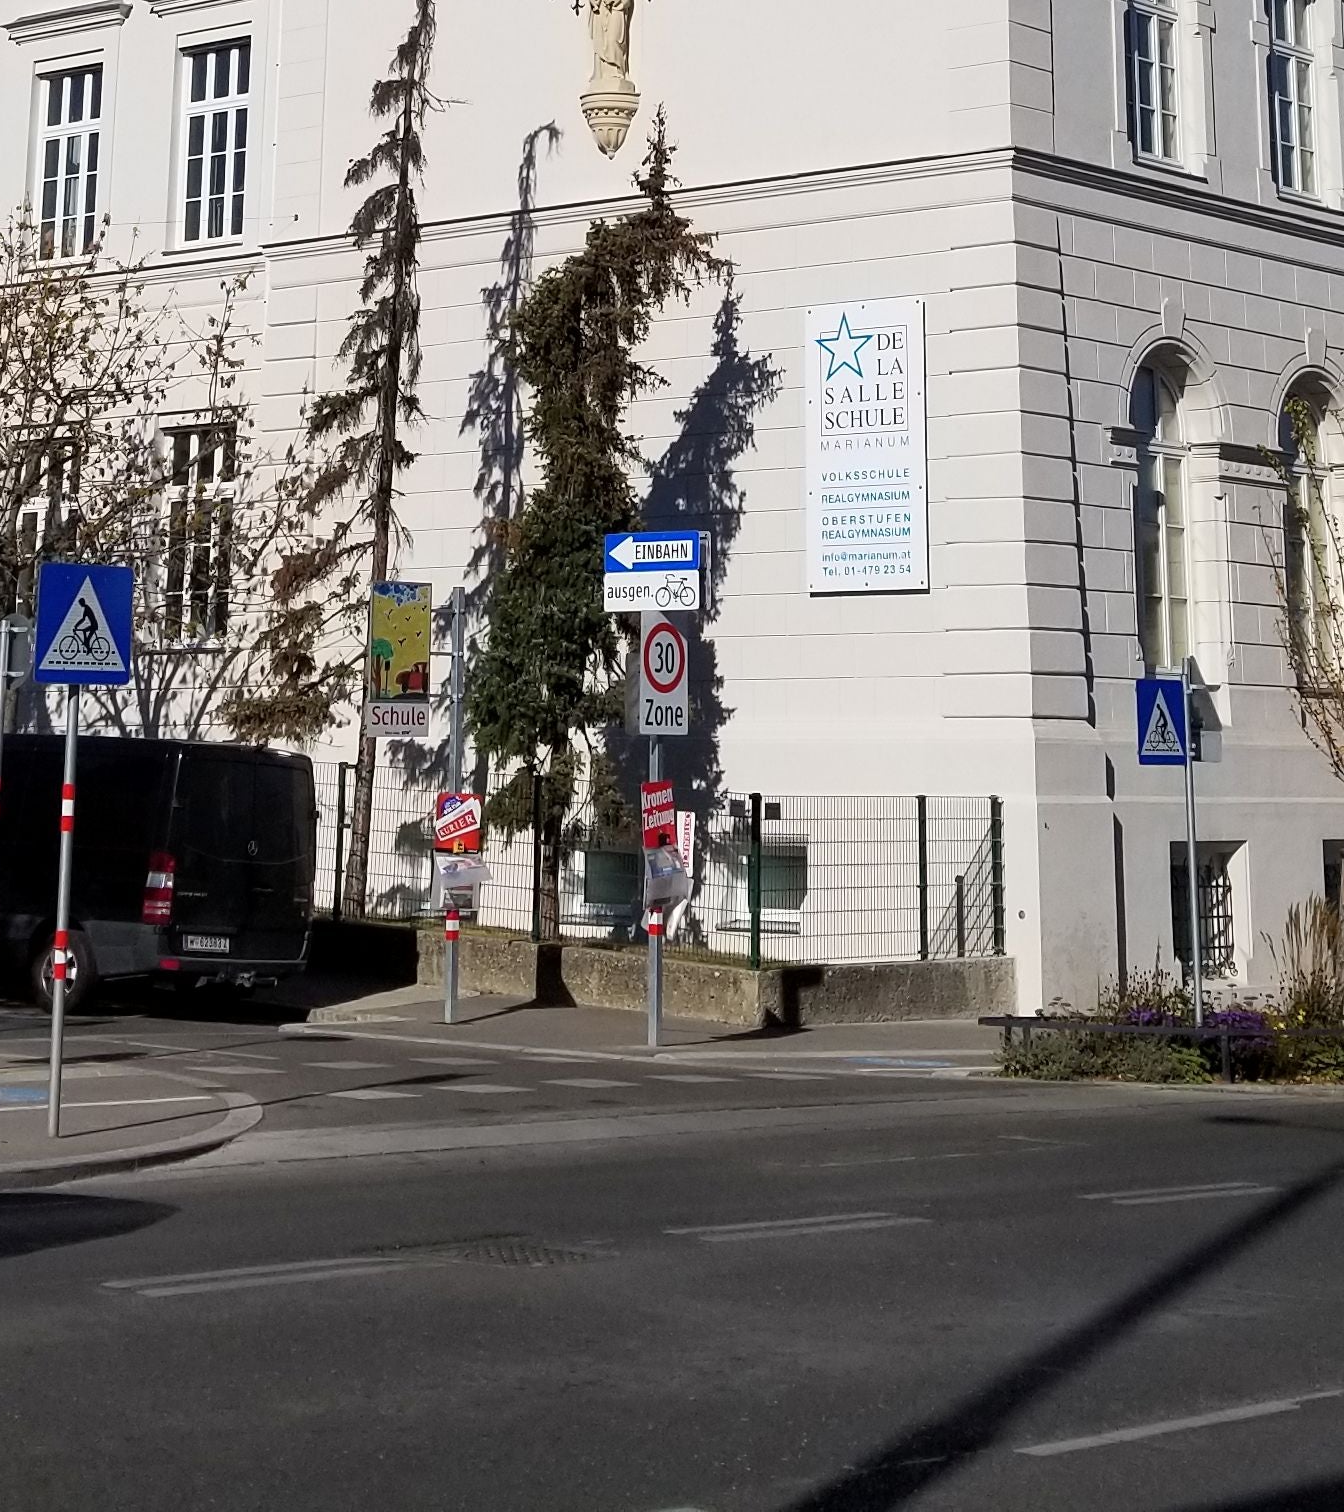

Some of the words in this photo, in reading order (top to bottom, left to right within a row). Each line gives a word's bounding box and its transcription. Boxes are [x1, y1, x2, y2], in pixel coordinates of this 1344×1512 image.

[877, 332, 904, 351] DE
[877, 357, 904, 376] LA
[824, 382, 904, 405] SALLE
[824, 407, 904, 430] SCHULE
[821, 435, 910, 452] MARIANUM
[821, 468, 910, 482] VOLKSSCHULE
[821, 491, 910, 505] REALGYMNASIUM
[822, 512, 911, 526] OBERSTUFEN
[821, 527, 911, 541] REALGYMNASIUM
[635, 542, 688, 561] EINBAHN
[822, 549, 911, 562] info@marianum.at
[883, 564, 896, 575] 23
[899, 564, 911, 574] 54
[607, 584, 654, 602] ausgen.
[654, 642, 675, 674] 30
[371, 705, 426, 726] Schule
[645, 699, 683, 727] Zone
[641, 787, 674, 809] Kronen
[439, 814, 476, 838] KURIER
[642, 807, 675, 831] Zeitung
